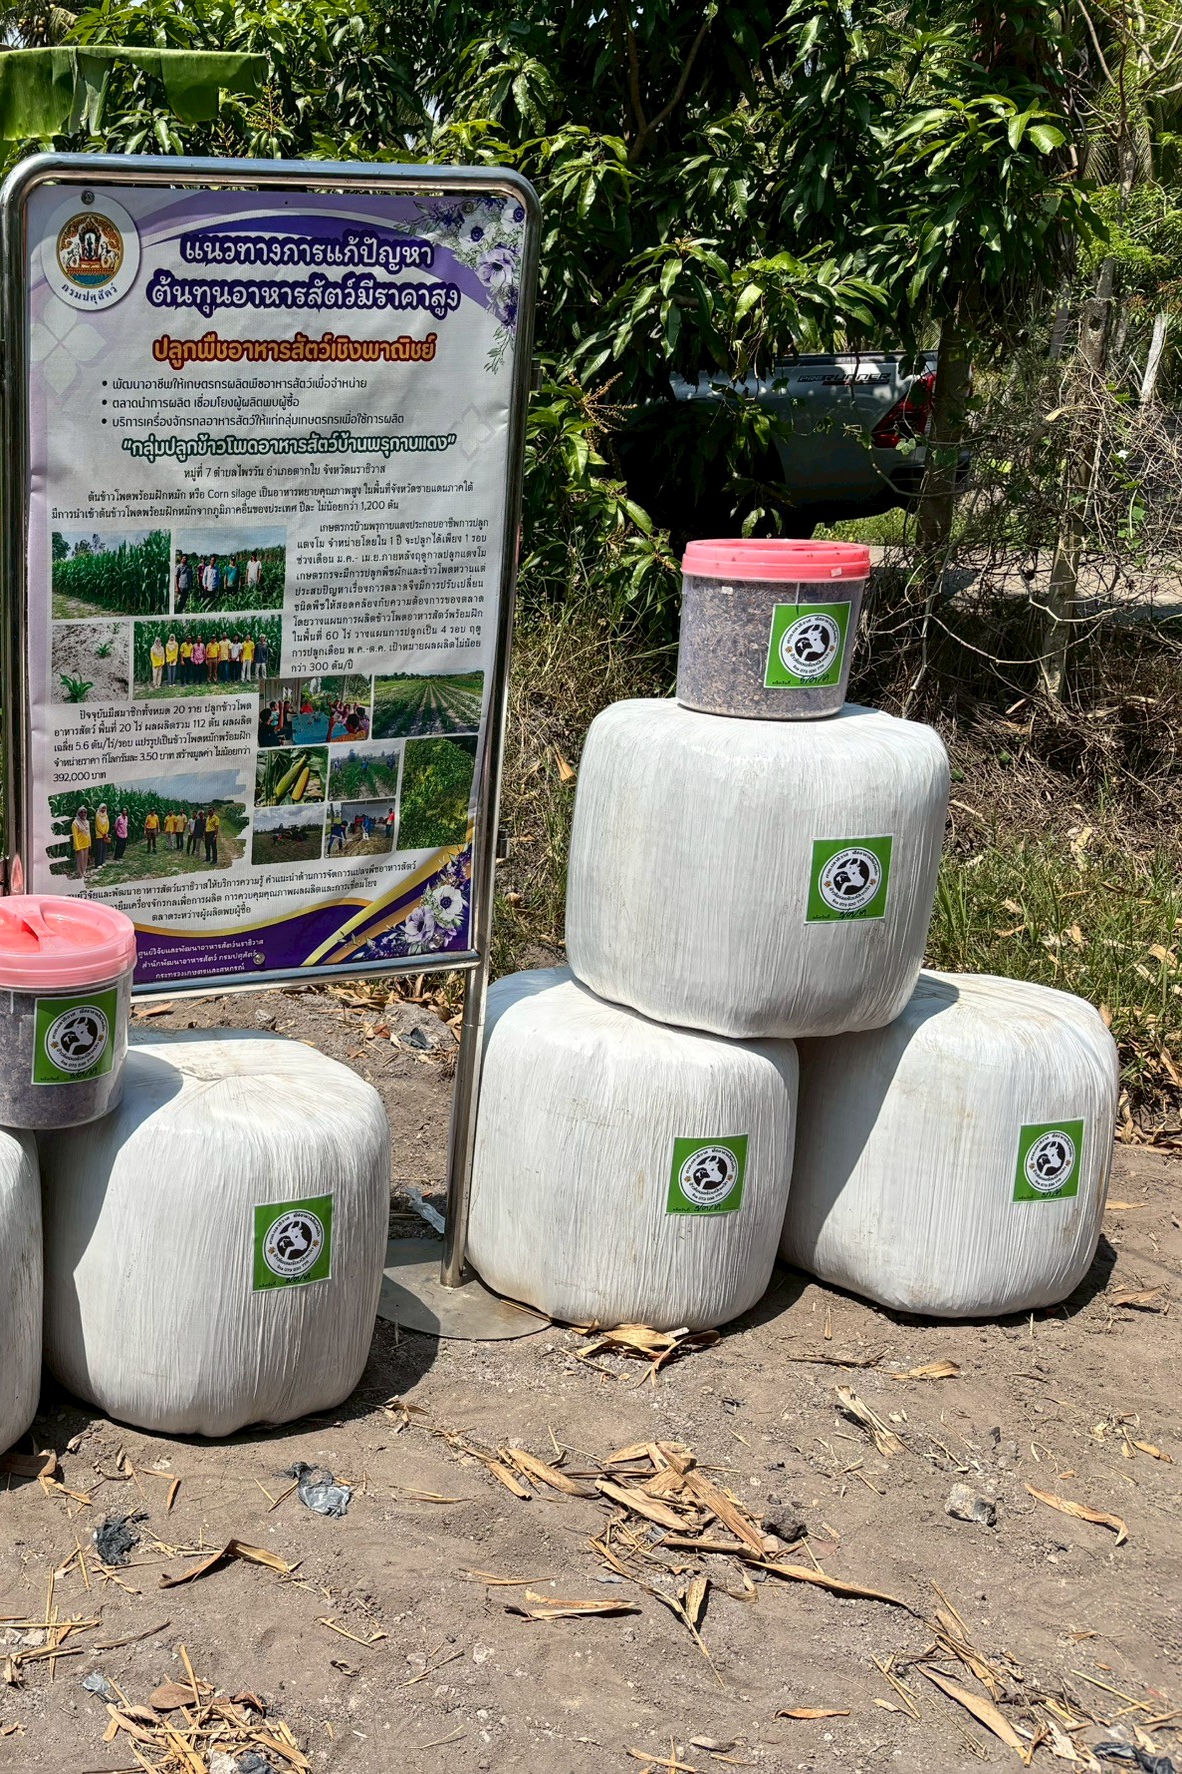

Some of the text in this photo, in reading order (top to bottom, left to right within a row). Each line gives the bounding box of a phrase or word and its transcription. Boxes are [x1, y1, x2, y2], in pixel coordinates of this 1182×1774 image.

[185, 235, 433, 273] แนวทางการแก้ปัญหา
[61, 282, 118, 305] กรมปศุสัตว์
[151, 274, 461, 315] ต้นทุนอาหารสัตว์มีราคาสูง
[153, 331, 436, 369] ปลูกพืชอาหารสัตว์เชิงพาณิชย์
[112, 375, 368, 390] พัฒนาอาชีพให้เกษตรกรผลิตพืชอาหารสัตว์เพื่อจำหน่าย
[112, 393, 300, 411] ตลาดนำการผลิต เชื่อมโยงผู้ผลิตพบผู้ซื้อ
[184, 463, 386, 482] หมู่ที่ ตำบลไพรวัน อำเภอตากใบ จังหวัดนราธิวาส
[87, 480, 474, 502] ต้นข้าวโพดพร้อมฝักหมัก หรือ Corn silage เป็นอาหารหยาบคุณภาพสูง ในพื้นที่จังหวัดชายแดนภาคใต้
[299, 501, 315, 513] ปีละ
[317, 500, 359, 513] ไม่น้อยกว่า
[361, 501, 385, 512] 1,200
[292, 624, 438, 642] ในพื้นที่ 60 วางแผนการปลูกเป็น
[309, 658, 354, 672] 300 ตัน/ปี
[173, 704, 186, 715] 20
[54, 718, 206, 737] อาหารสัตว์ 20 ผลผลิตรวม 112
[53, 771, 90, 782] 392,000
[151, 901, 252, 921] ตลาดระหว่างผู้ผลิตพบผู้ซื้อ
[155, 963, 245, 979] กระทรวงเกษตรและสหกรณ์
